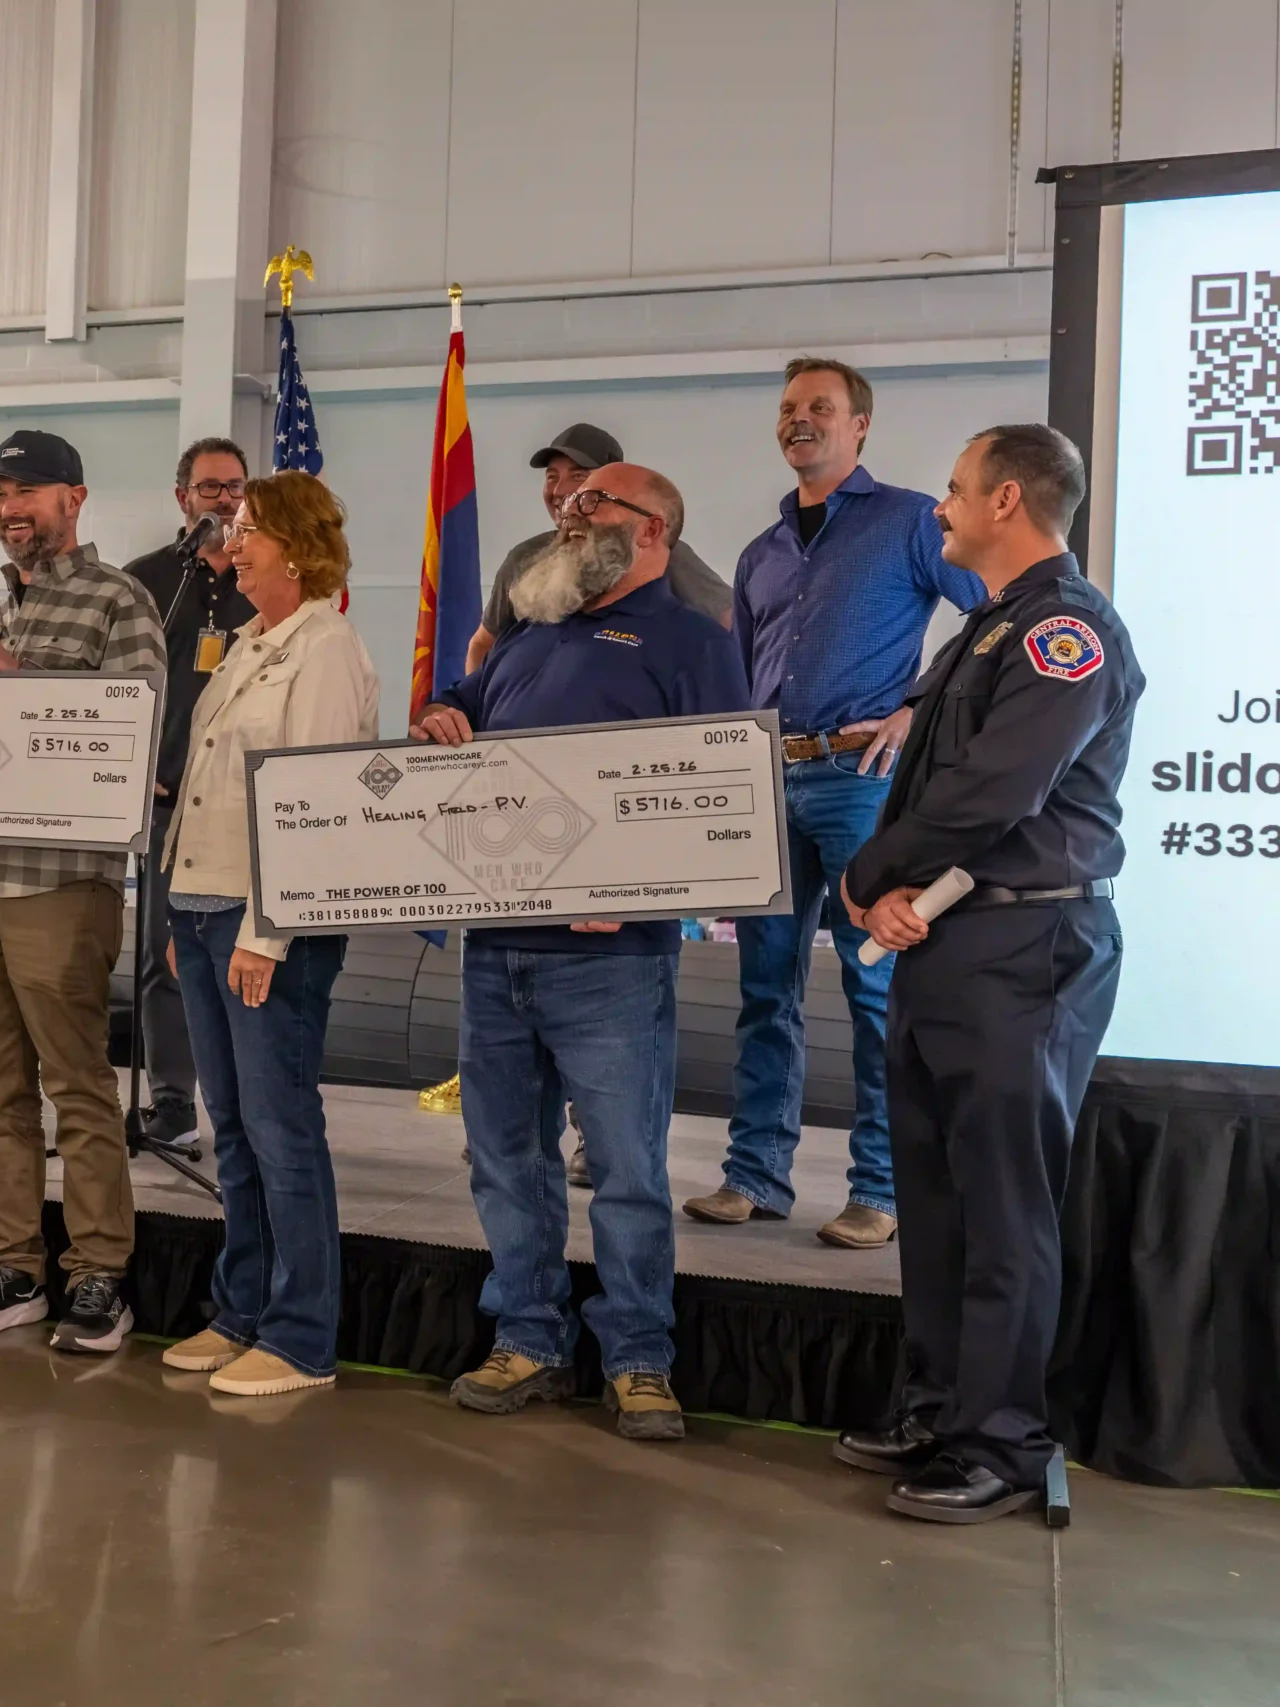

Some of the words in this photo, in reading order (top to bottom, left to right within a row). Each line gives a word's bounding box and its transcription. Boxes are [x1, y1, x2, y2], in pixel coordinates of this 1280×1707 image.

[1030, 619, 1072, 639] CENTRAL
[1074, 623, 1101, 656] ARIZONA
[1047, 666, 1070, 677] FIRE
[105, 686, 140, 698] 00192
[20, 711, 39, 720] Date
[704, 729, 749, 744] 00192
[406, 752, 482, 764] 100MENWHOCARE
[406, 759, 508, 773] 100menwhocareyc.com
[93, 772, 127, 783] Dollars
[598, 770, 621, 780] Date
[274, 802, 295, 814] Pay
[297, 800, 310, 811] To
[36, 817, 72, 827] Signature
[362, 807, 427, 824] HEALING
[275, 818, 296, 830] The
[299, 815, 331, 829] Order
[333, 815, 347, 827] Of
[707, 829, 752, 842] Dollars
[1160, 821, 1280, 859] #333
[474, 864, 503, 878] MEN
[512, 861, 543, 876] WHO
[280, 890, 315, 901] Memo
[326, 889, 350, 900] THE
[354, 886, 401, 898] POWER
[403, 885, 421, 896] OF
[424, 883, 447, 894] 100
[588, 887, 640, 899] Authorized
[643, 886, 690, 898] Signature
